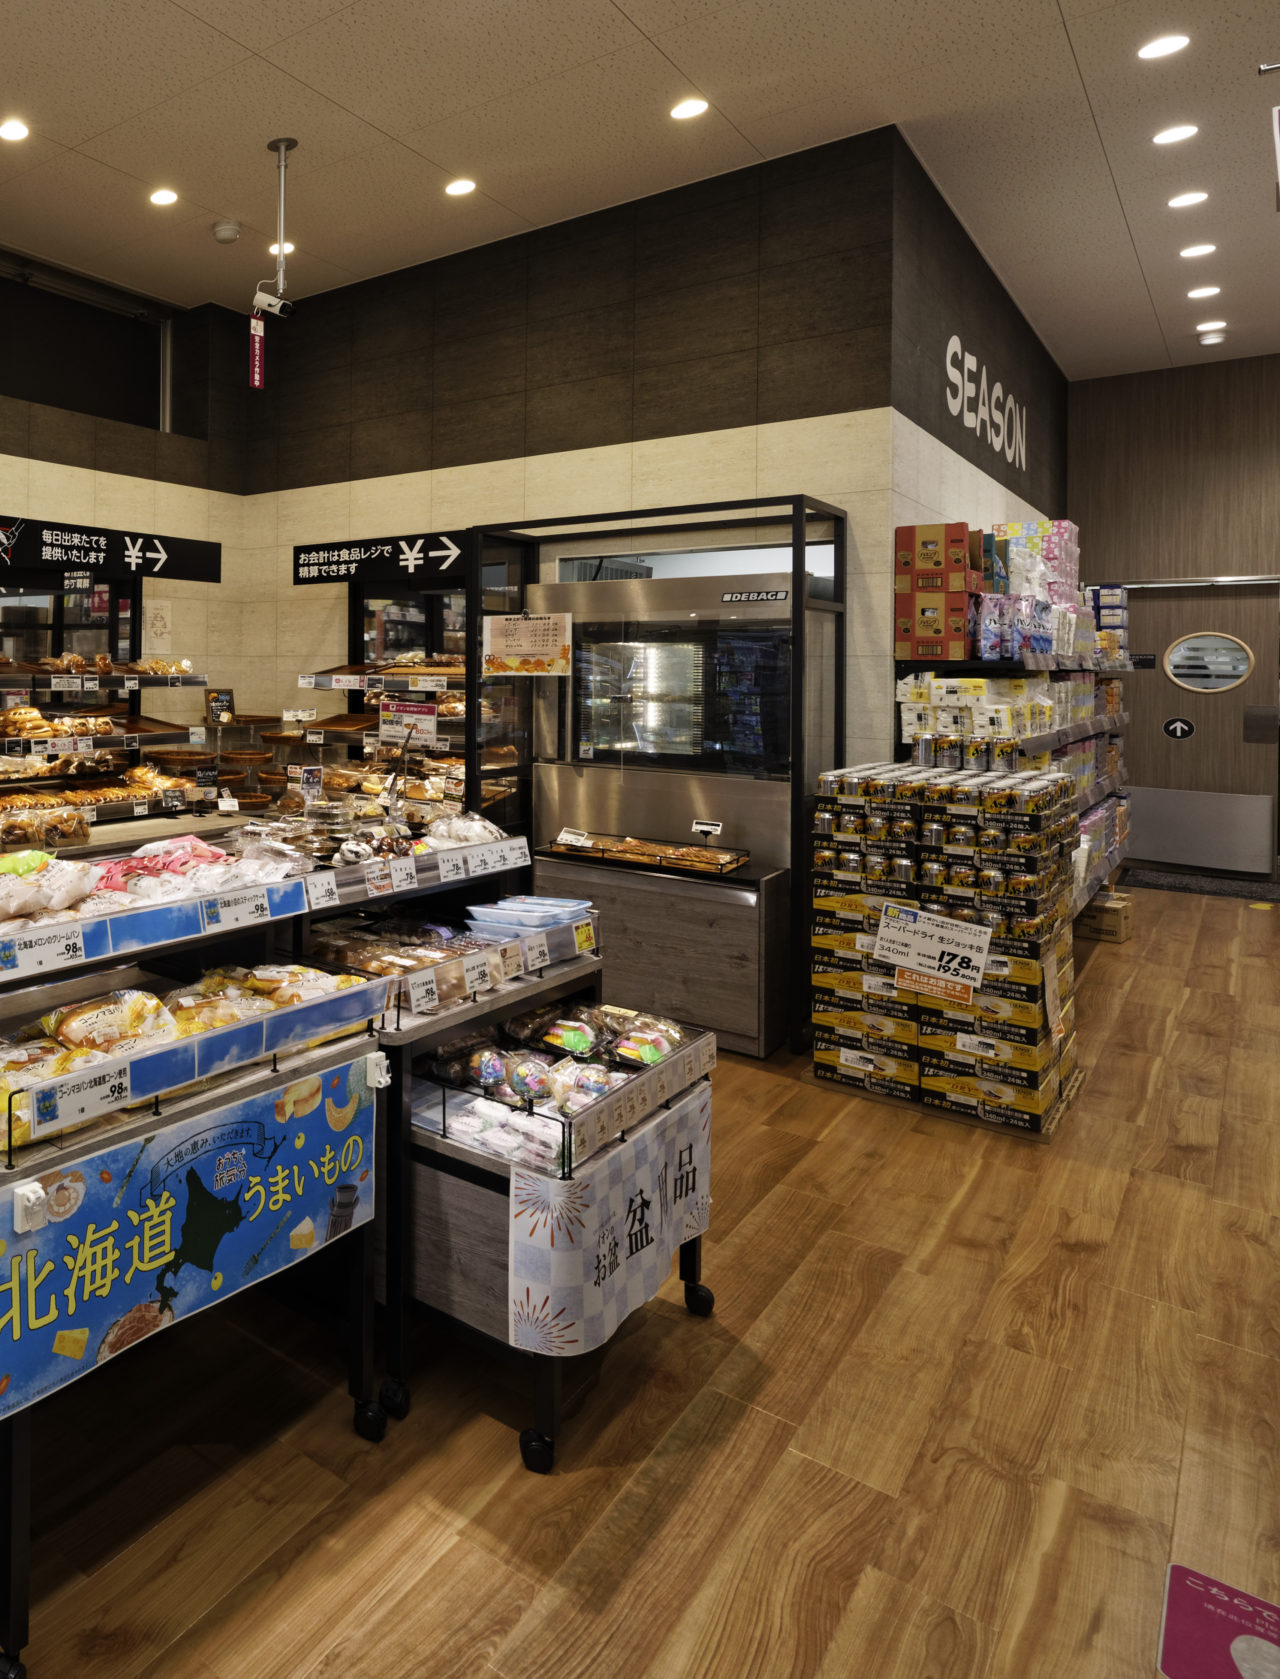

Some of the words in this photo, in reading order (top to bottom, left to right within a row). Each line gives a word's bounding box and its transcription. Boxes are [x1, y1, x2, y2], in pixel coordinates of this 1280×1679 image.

[946, 334, 1026, 472] SEASON
[42, 529, 108, 549] 毎日出来たてを
[42, 546, 106, 564] 提供いたします
[298, 545, 393, 564] お会計は食品レジで
[298, 562, 359, 579] 精算できます
[732, 592, 776, 601] DEBAG
[17, 930, 80, 951] 北海道メロンのクリームパン
[883, 921, 936, 940] スーパードライ
[937, 935, 985, 954] 生ジョッキ缶
[878, 944, 909, 958] 340ml
[937, 950, 981, 974] 178円
[58, 1067, 127, 1099] コーンマヨパン北海道産コーン使用
[216, 1147, 246, 1171] おうちで
[214, 1162, 247, 1190] 旅気分
[242, 1134, 364, 1222] うまいもの
